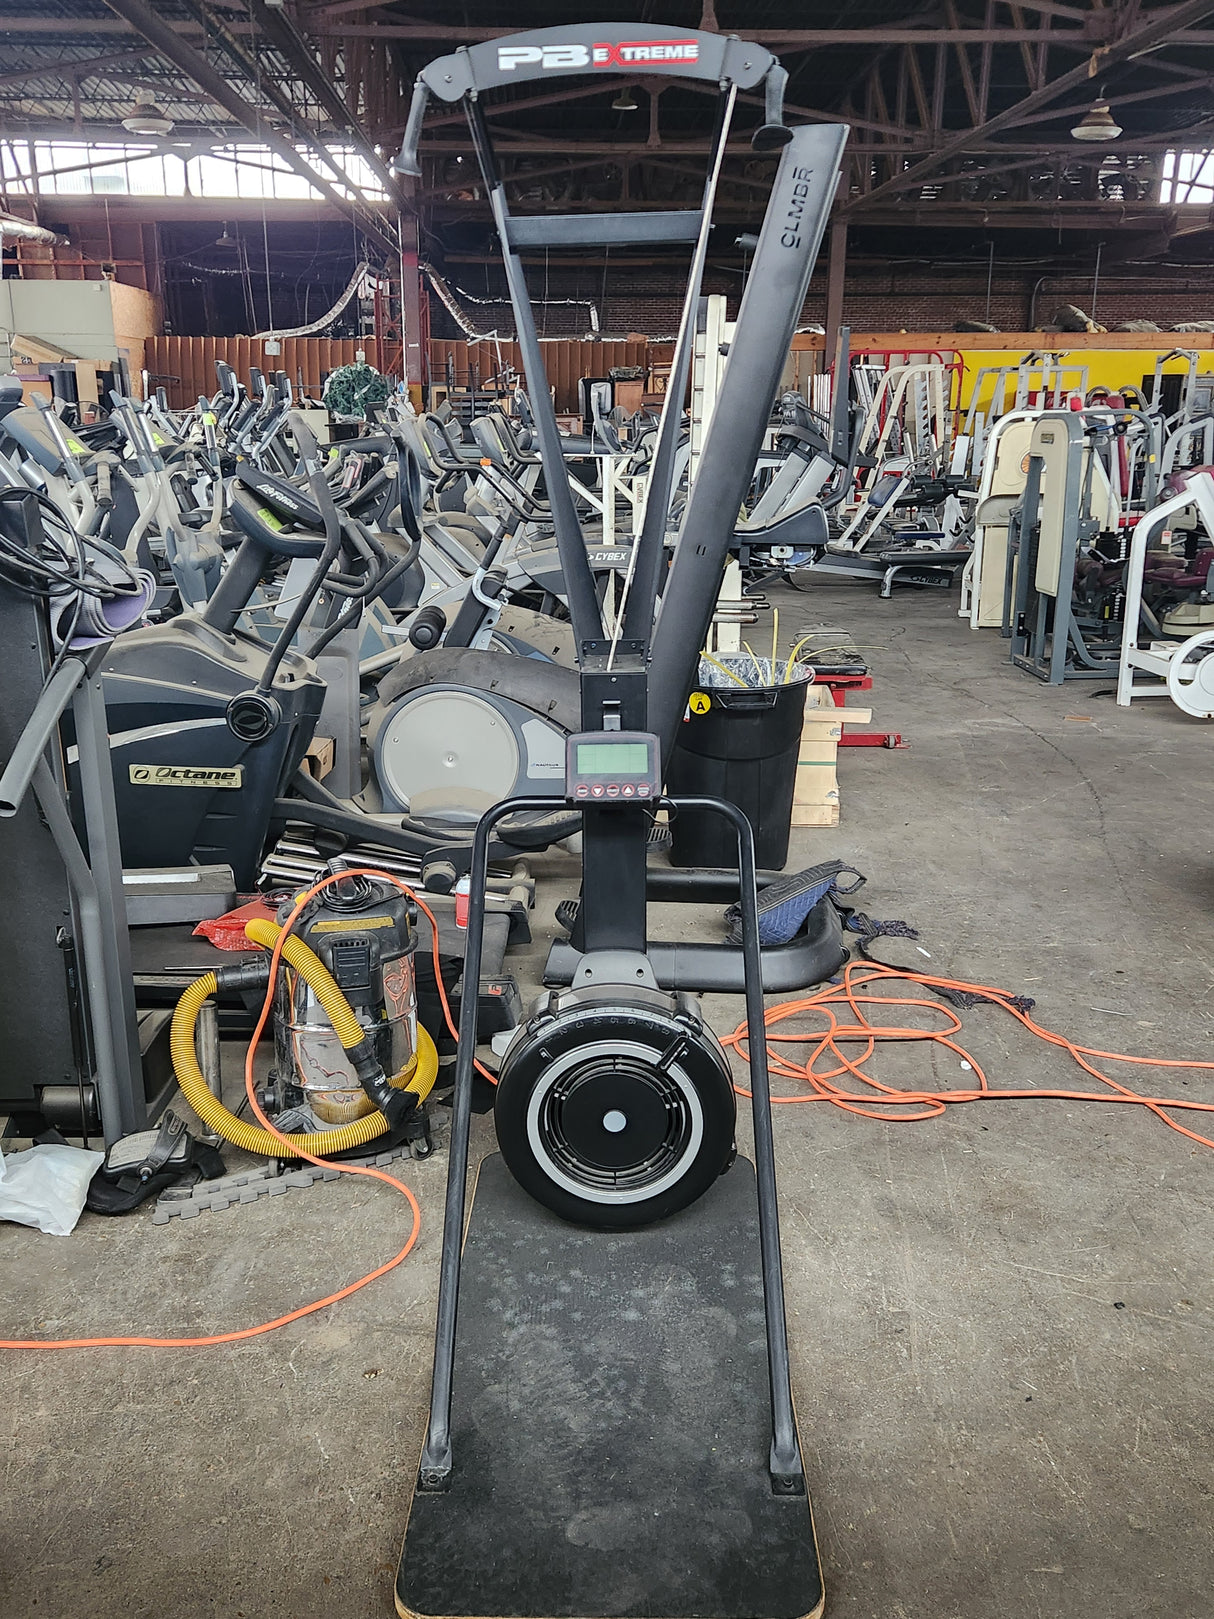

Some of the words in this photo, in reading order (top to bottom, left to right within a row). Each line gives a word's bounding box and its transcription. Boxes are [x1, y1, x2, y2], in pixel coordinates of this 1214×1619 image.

[498, 45, 590, 71] PB
[593, 40, 699, 67] EXTREME
[781, 166, 813, 249] CLMBR
[594, 552, 627, 561] CYBEX
[696, 701, 705, 712] A
